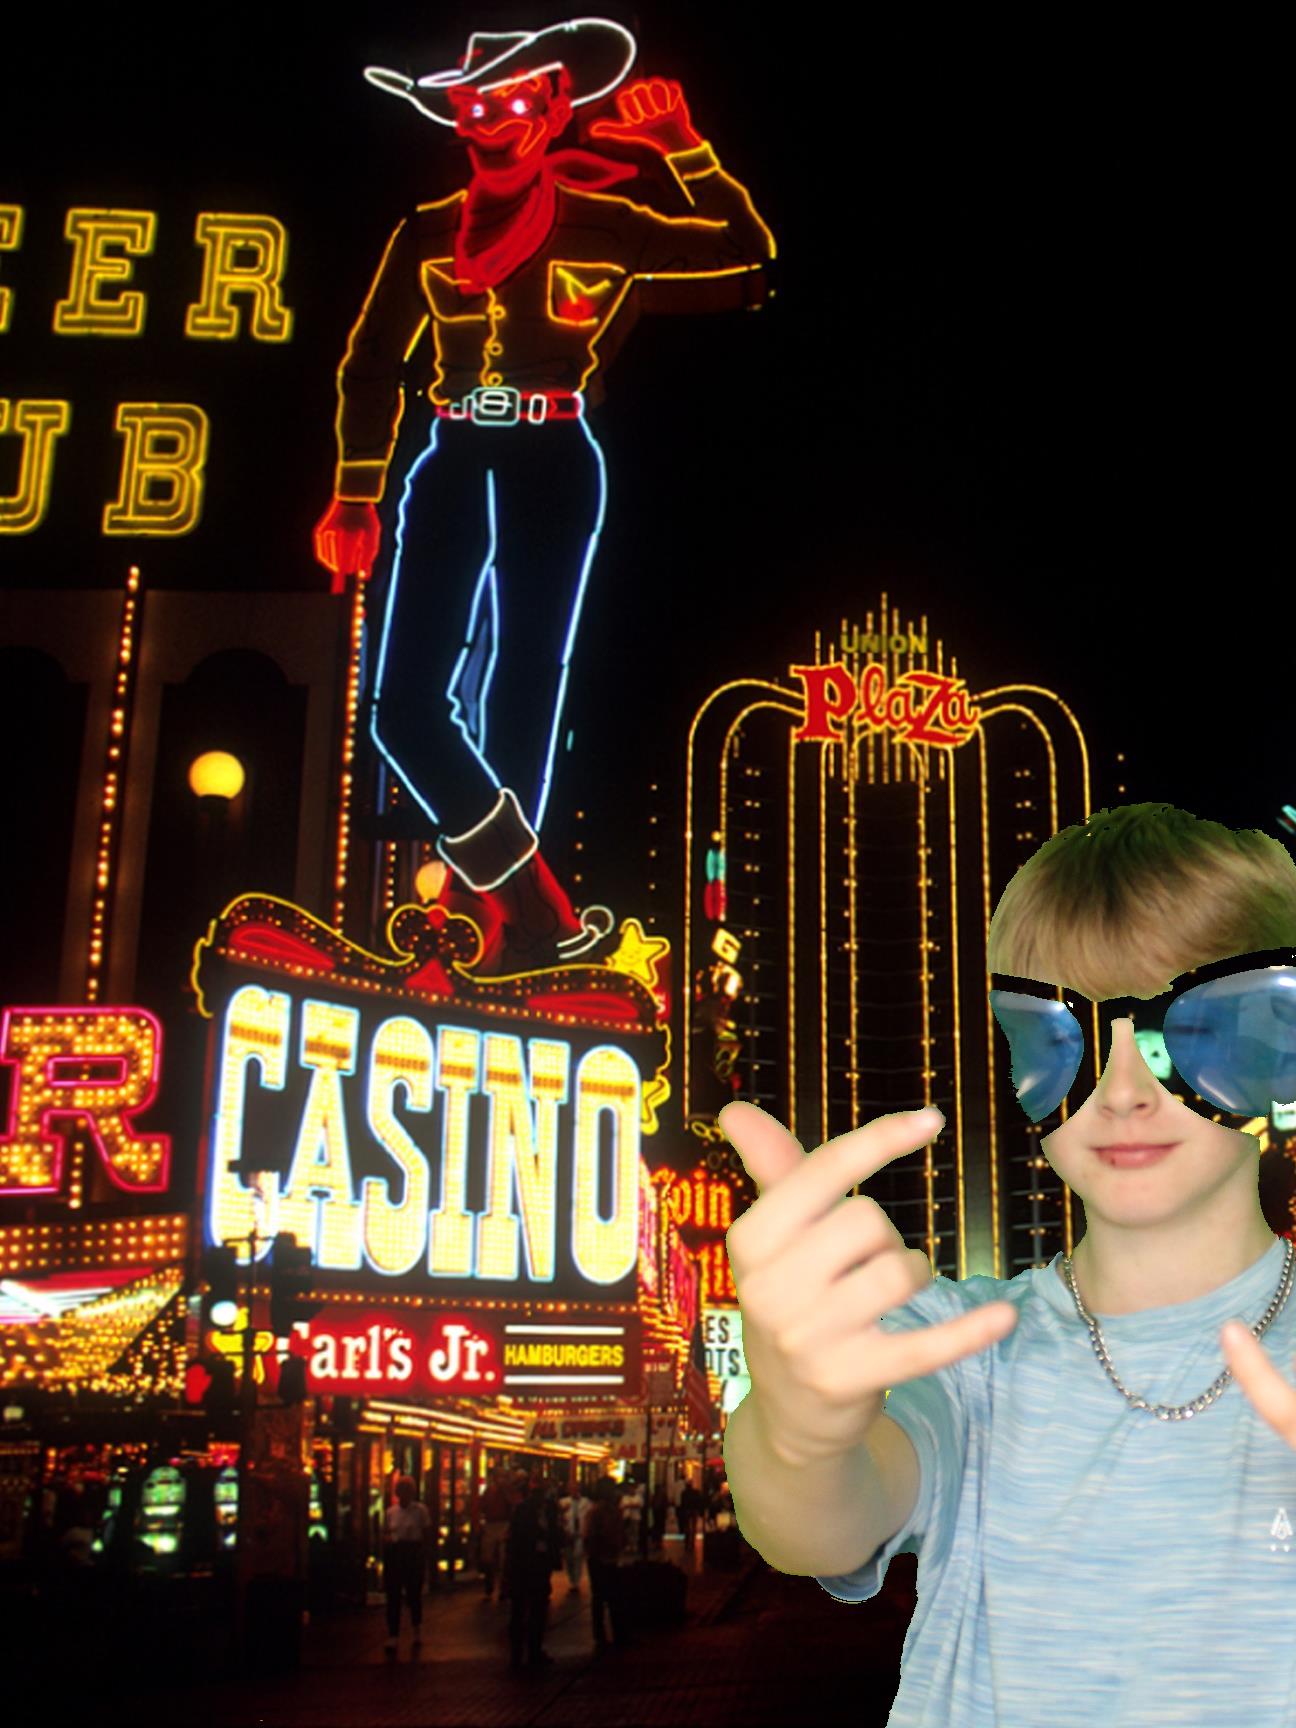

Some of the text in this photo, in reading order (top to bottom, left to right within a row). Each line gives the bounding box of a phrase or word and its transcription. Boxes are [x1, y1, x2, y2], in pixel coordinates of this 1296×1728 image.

[0, 203, 293, 342] ER
[840, 630, 928, 655] UNION
[210, 985, 641, 1285] CASINO
[428, 1323, 496, 1382] Jr.
[503, 1343, 625, 1368] HAMBURGERS
